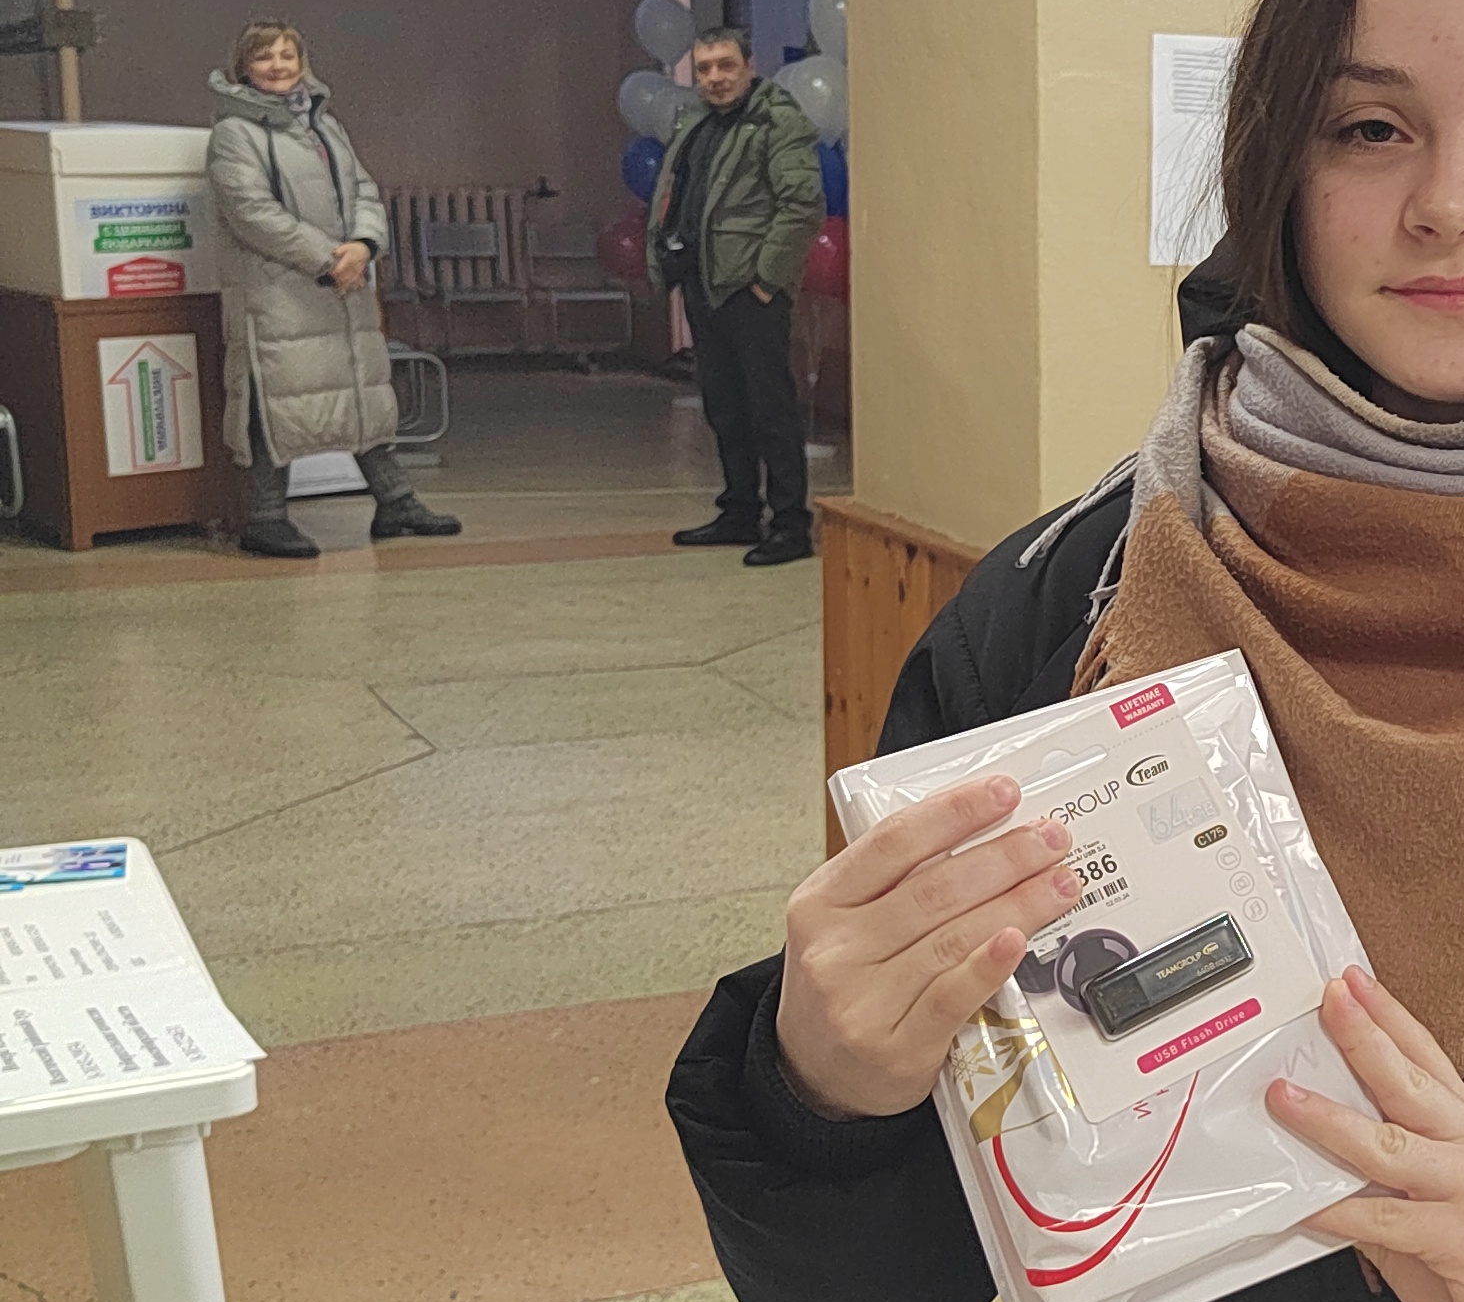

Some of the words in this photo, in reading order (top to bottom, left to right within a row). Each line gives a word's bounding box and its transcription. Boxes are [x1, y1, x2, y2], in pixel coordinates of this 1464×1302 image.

[90, 202, 191, 219] ВИКТОРИНА
[1119, 687, 1162, 713] LIFETIME
[1124, 697, 1165, 722] WARRANTY
[1041, 780, 1120, 825] GROUP
[1133, 759, 1169, 783] Team
[1197, 827, 1225, 846] C175
[1156, 951, 1202, 980] TEAMGROUP
[1153, 1044, 1179, 1063] USB
[1180, 1028, 1213, 1049] Flash
[1214, 1011, 1246, 1031] Drive
